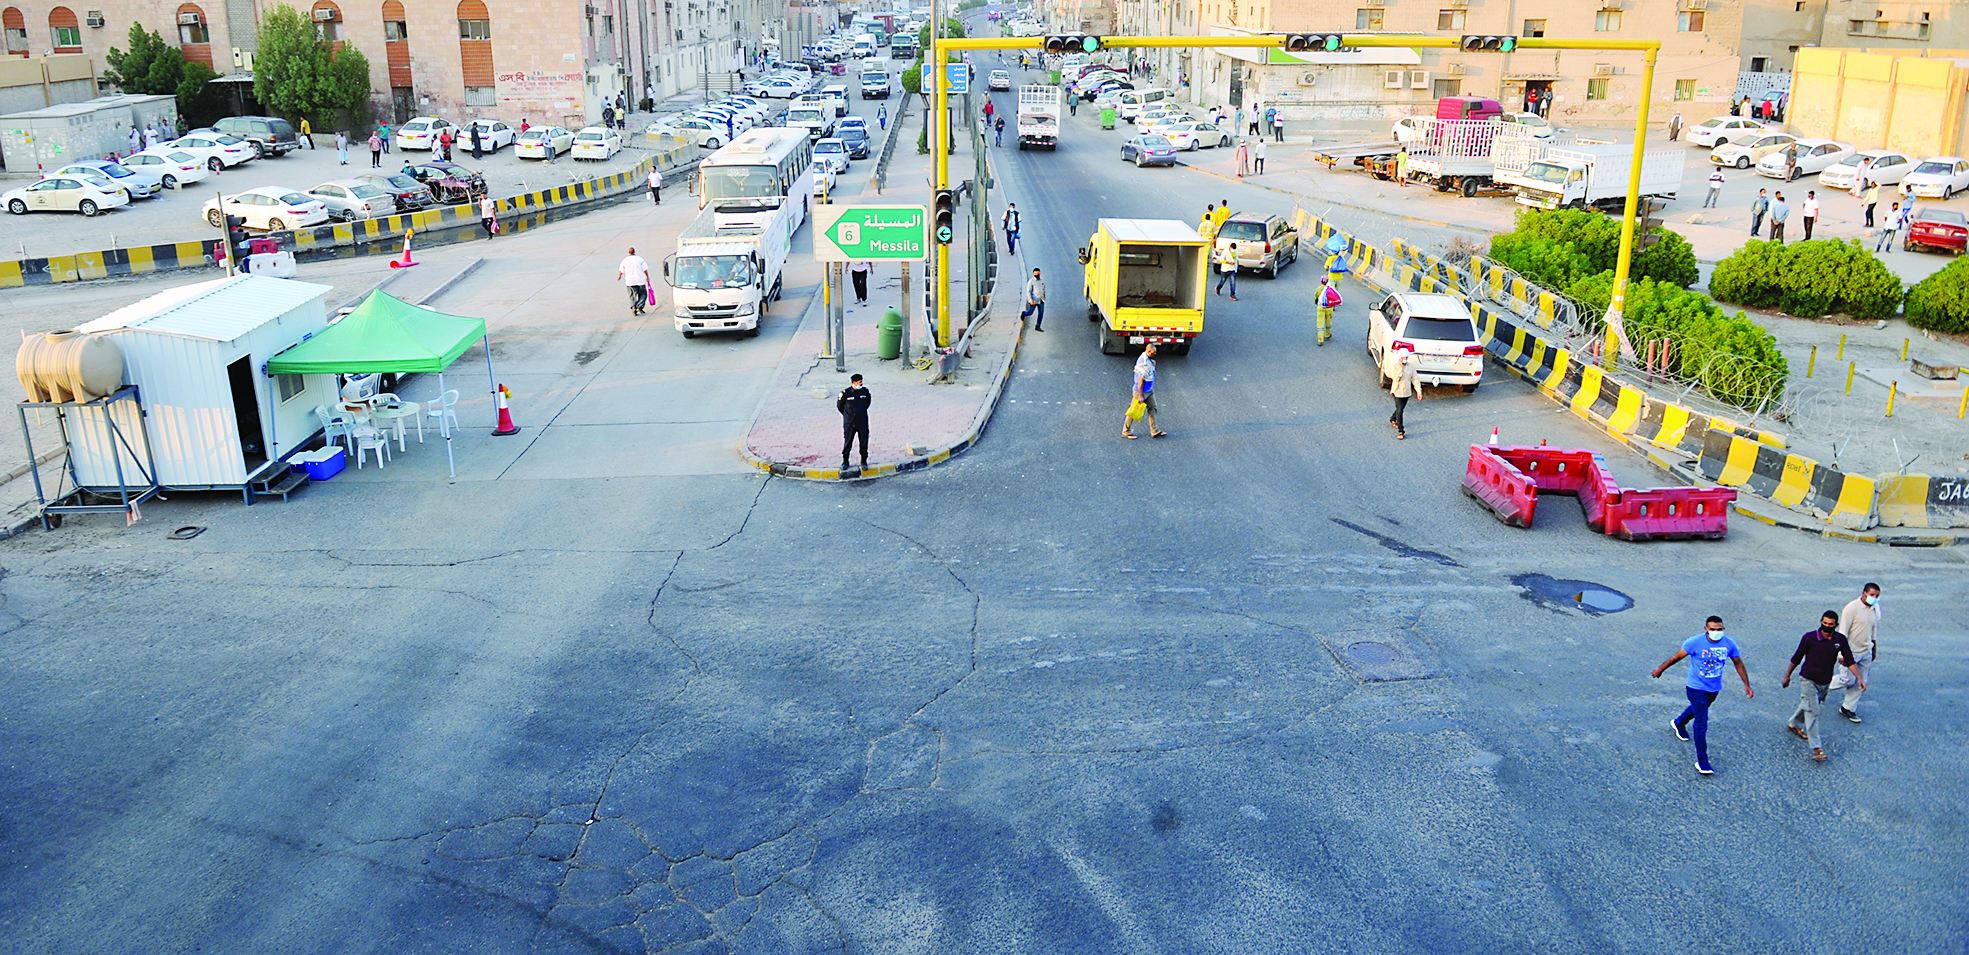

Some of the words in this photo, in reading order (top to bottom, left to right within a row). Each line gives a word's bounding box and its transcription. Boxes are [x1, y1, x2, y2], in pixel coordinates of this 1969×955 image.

[864, 213, 920, 230] المسيلة
[845, 230, 853, 241] 6
[870, 240, 919, 252] Messila
